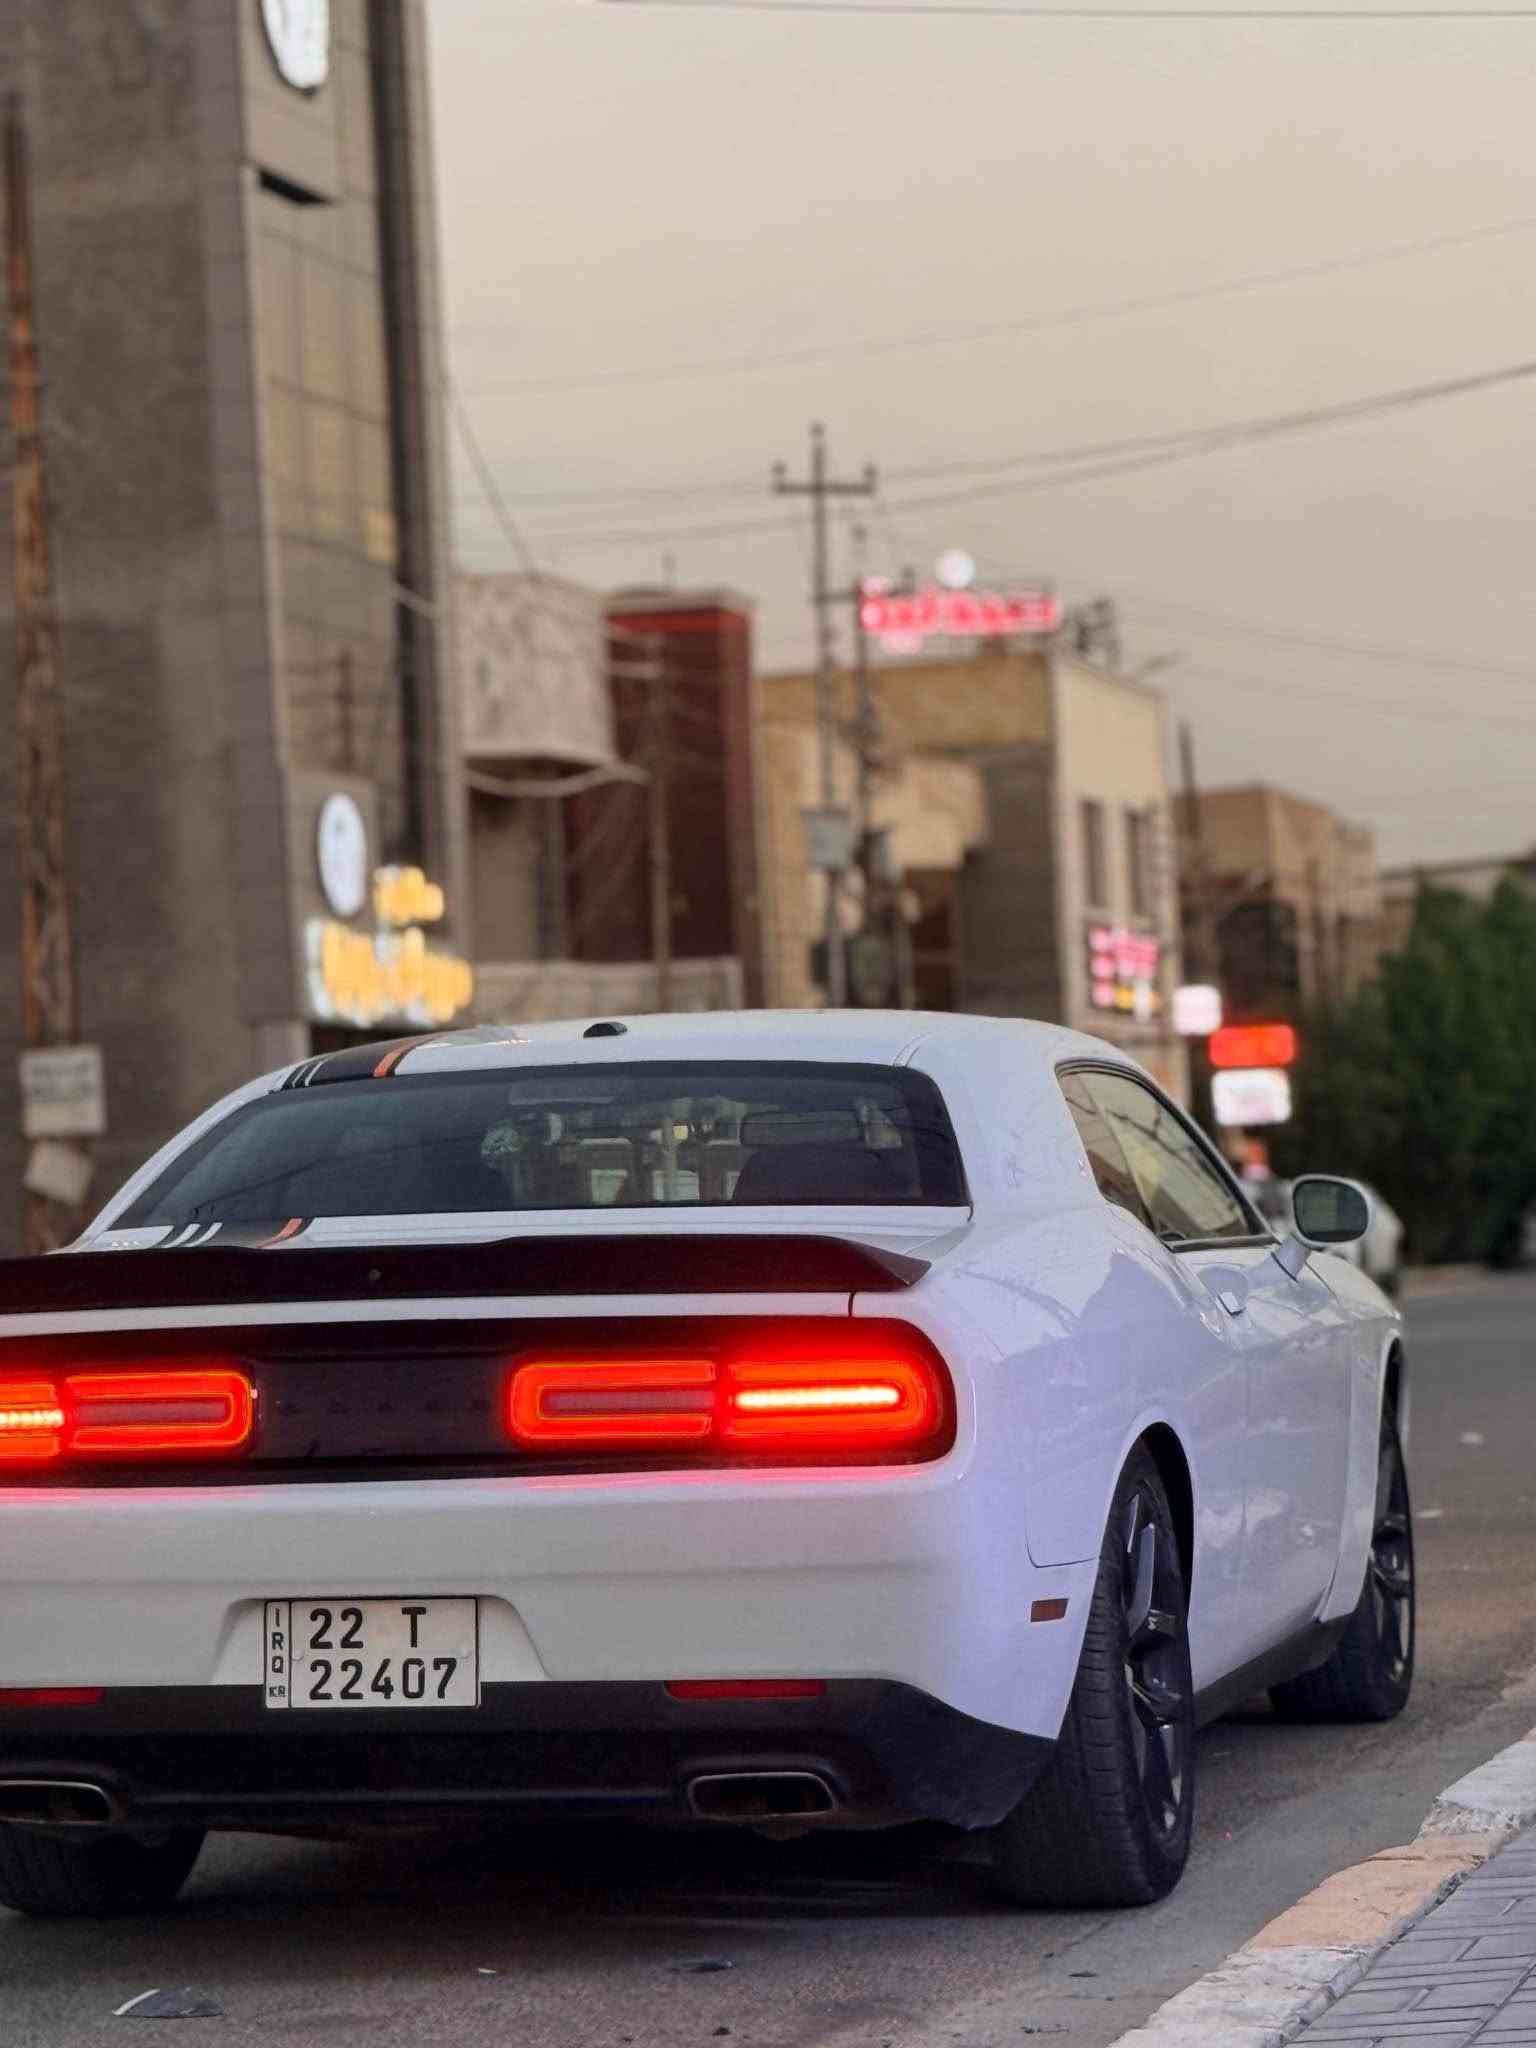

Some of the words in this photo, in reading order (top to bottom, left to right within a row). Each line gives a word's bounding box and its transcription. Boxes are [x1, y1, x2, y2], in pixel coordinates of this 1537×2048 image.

[271, 1607, 284, 1674] IRQ
[309, 1608, 364, 1649] 22
[401, 1606, 427, 1648] T
[309, 1658, 457, 1700] 22407
